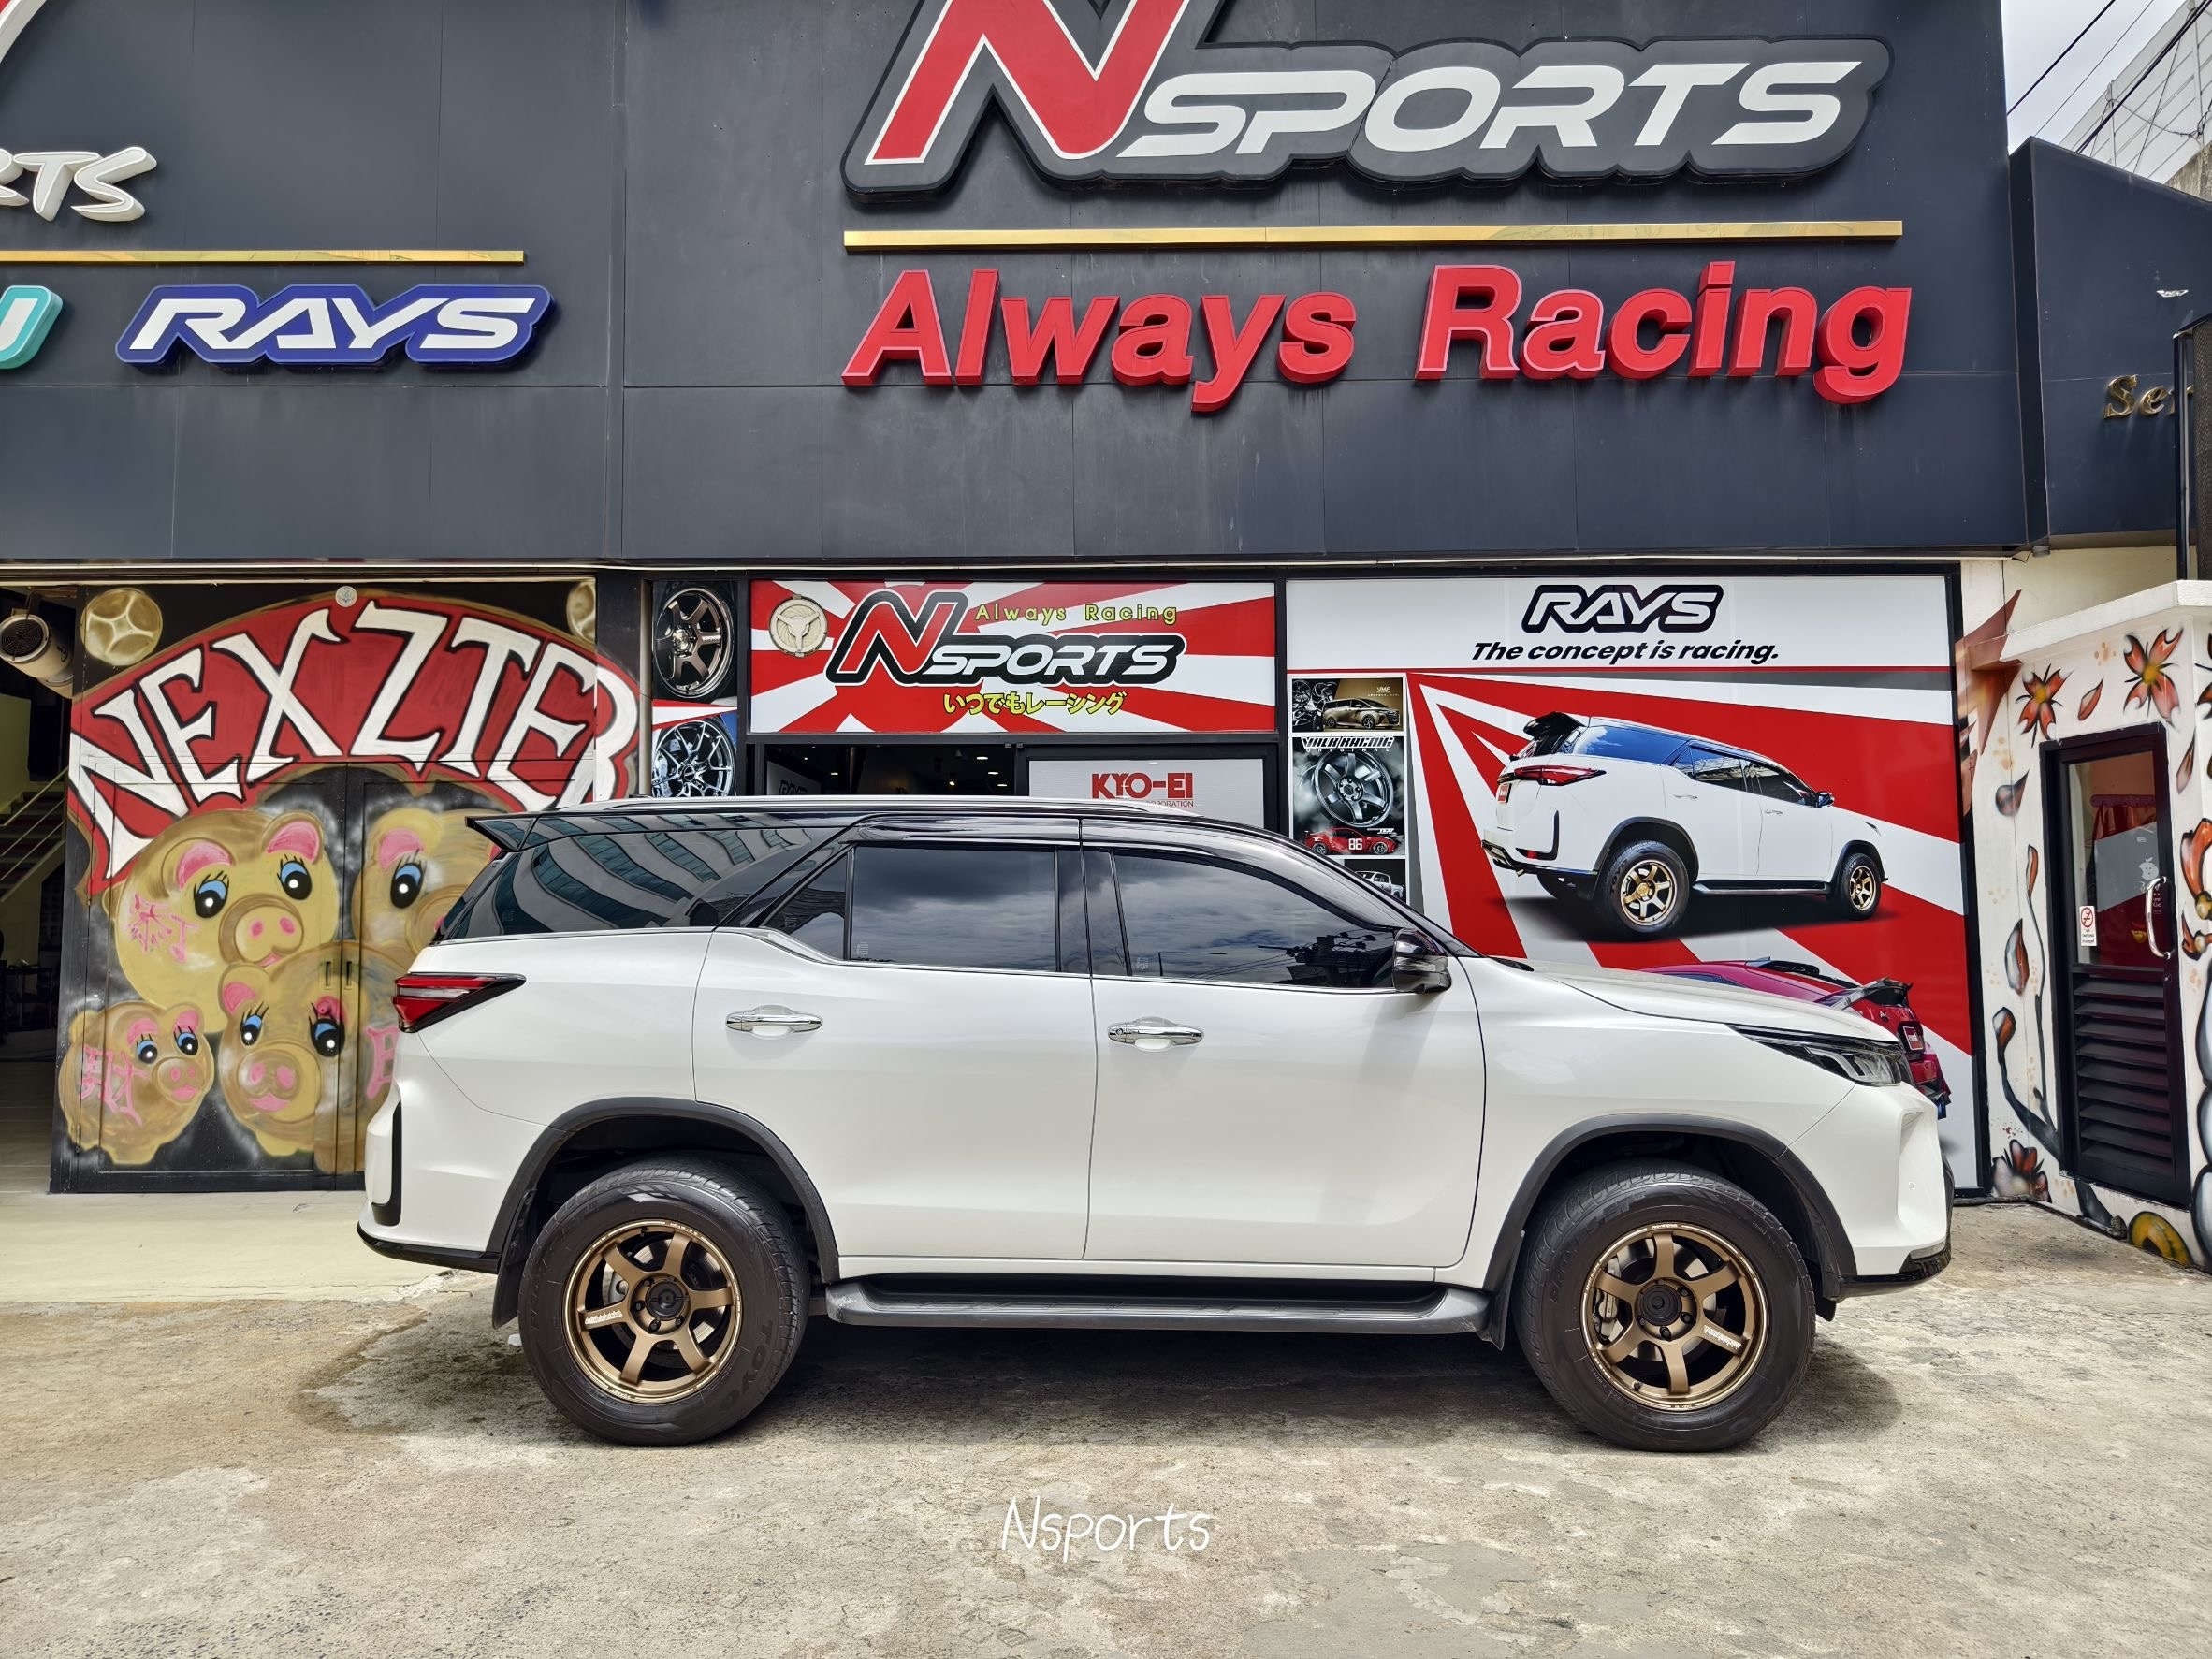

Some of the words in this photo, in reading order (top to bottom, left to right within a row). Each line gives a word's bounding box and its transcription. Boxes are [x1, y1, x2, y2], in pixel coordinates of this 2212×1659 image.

[129, 297, 535, 351] RAYS
[842, 269, 1357, 413] Always
[1416, 261, 1913, 404] Racing
[974, 604, 1067, 626] Always
[1084, 603, 1178, 626] Racing
[1524, 588, 1722, 629] RAYS
[1471, 641, 1523, 661] The
[1527, 642, 1649, 665] concept
[1649, 639, 1675, 660] is
[1678, 639, 1779, 665] racing.
[943, 691, 1128, 716] いつでもレーシング
[1091, 772, 1194, 799] KYO-EI
[1348, 837, 1363, 851] 86
